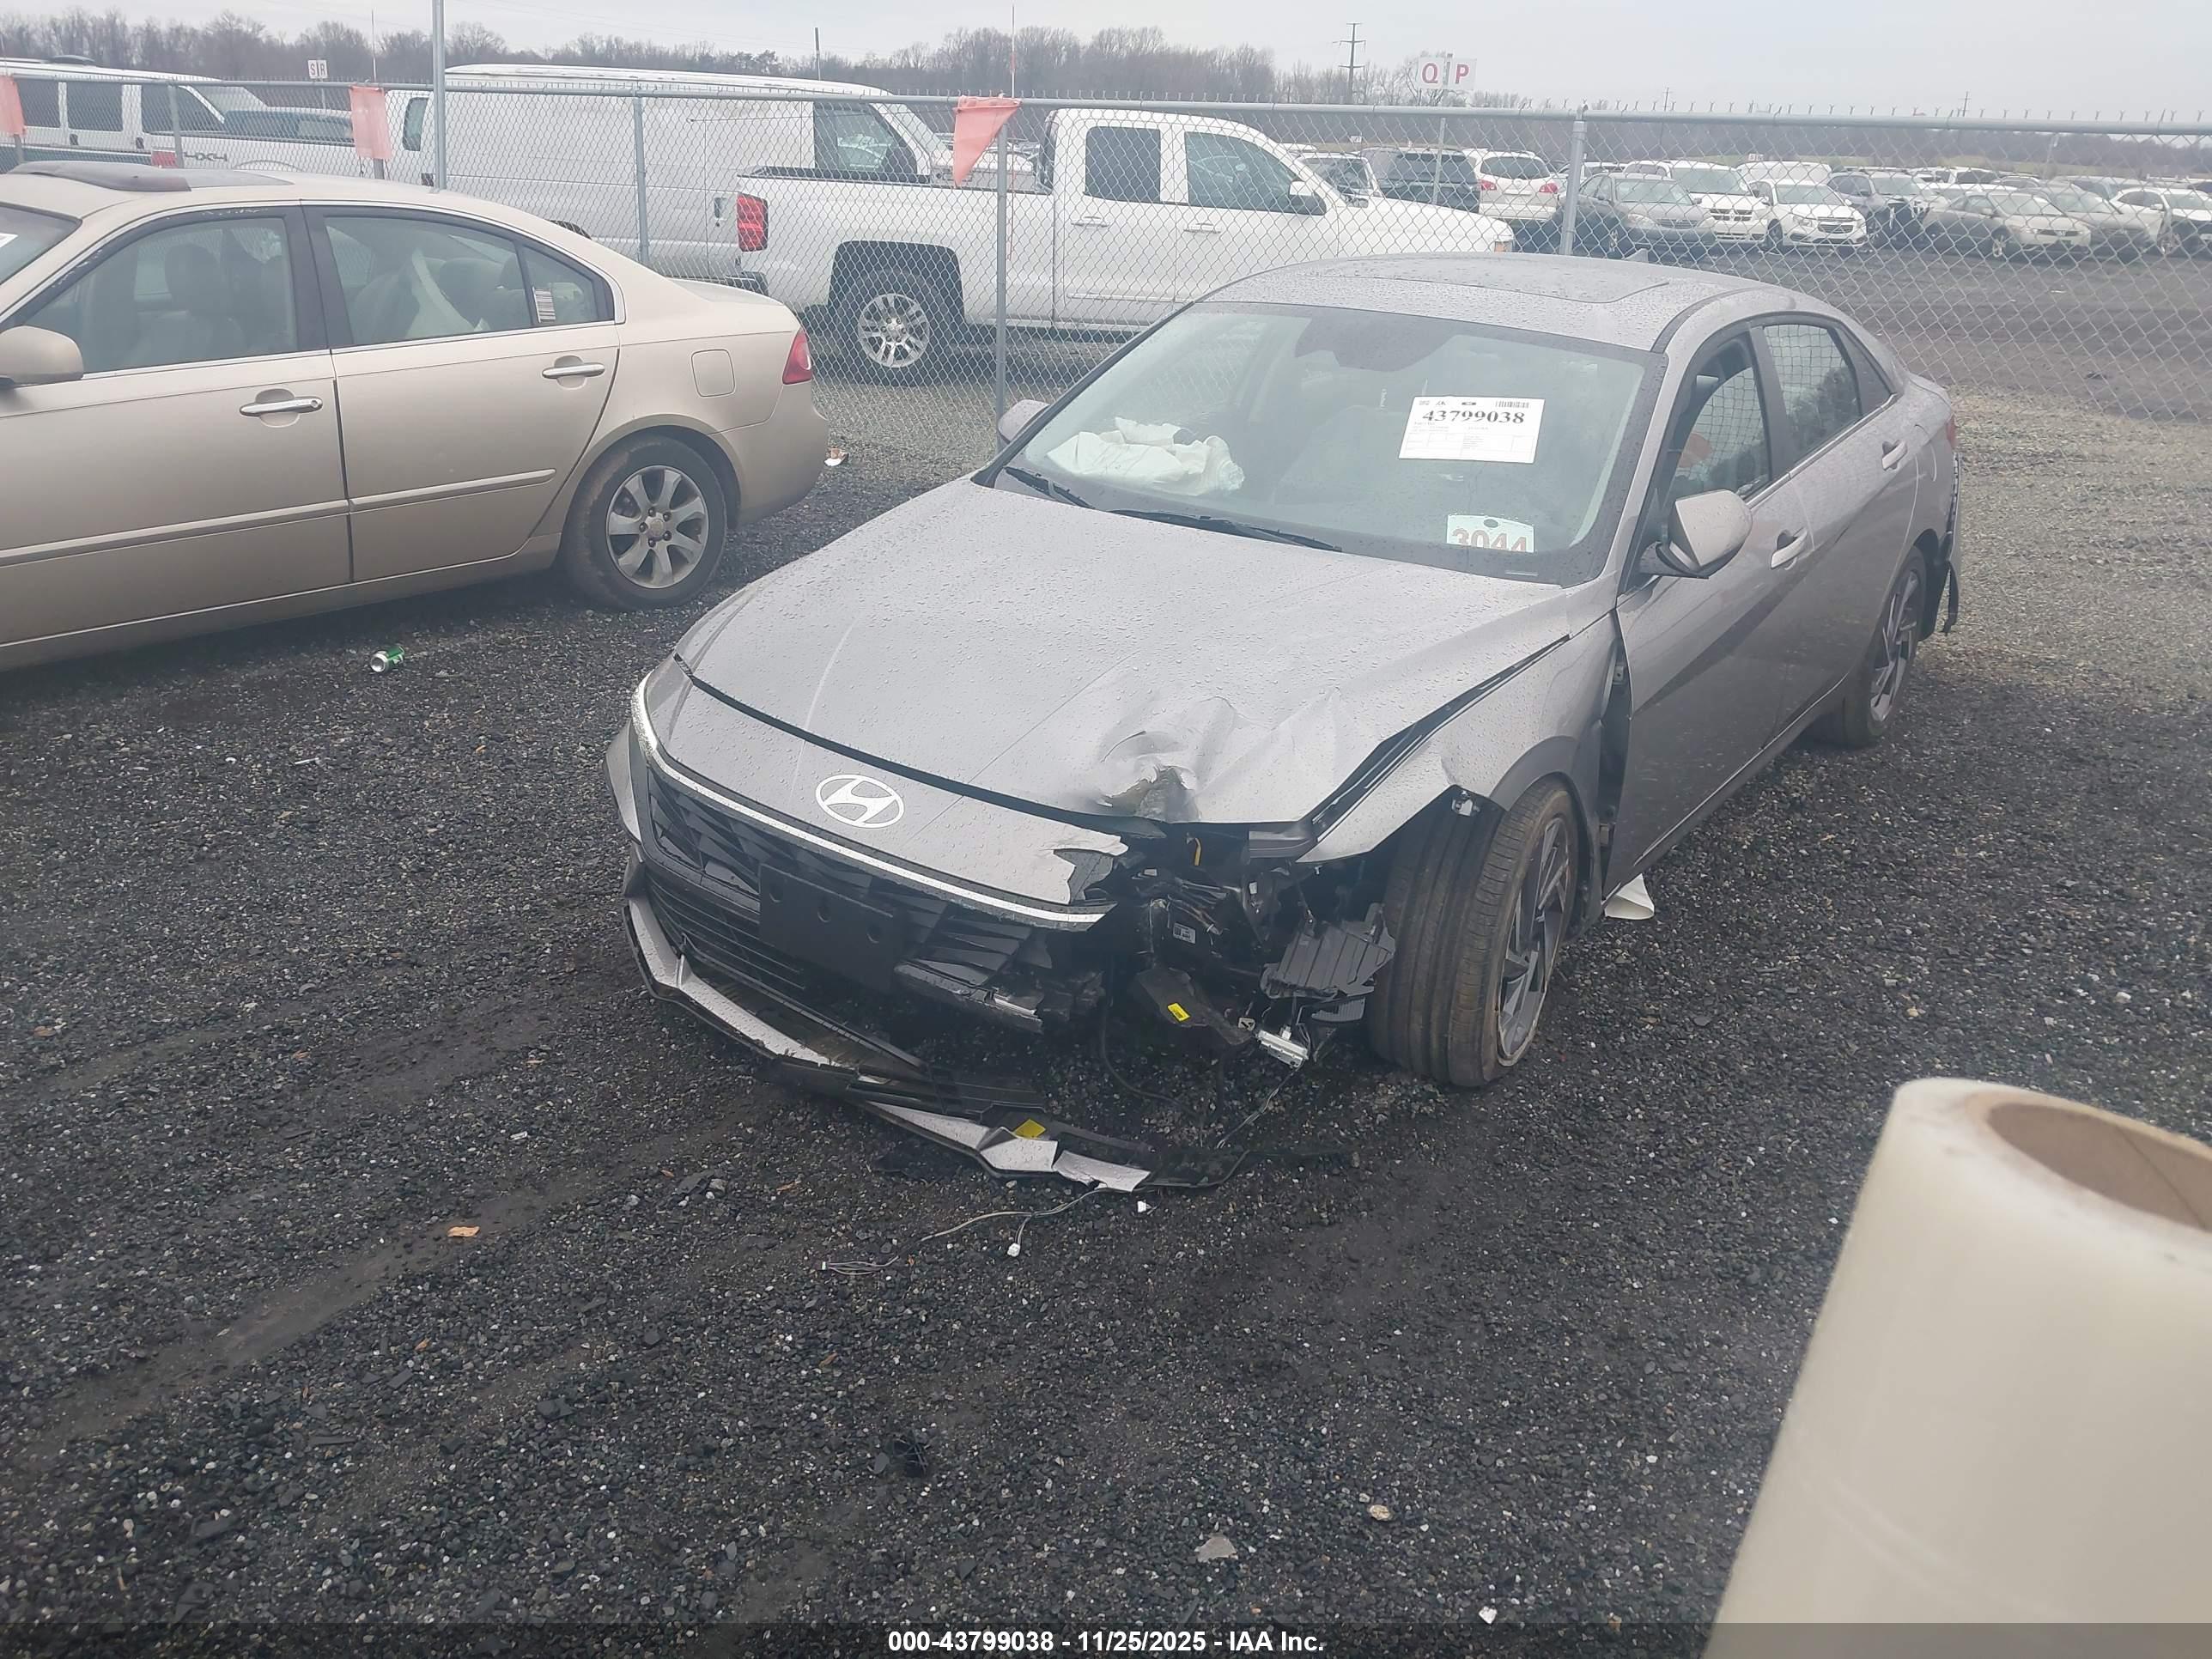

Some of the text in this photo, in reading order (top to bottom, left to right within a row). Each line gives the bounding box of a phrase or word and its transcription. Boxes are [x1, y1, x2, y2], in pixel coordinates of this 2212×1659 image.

[310, 63, 326, 76] S R
[1422, 63, 1469, 84] Q P
[1423, 410, 1525, 424] 43799038
[1452, 528, 1527, 551] 3044
